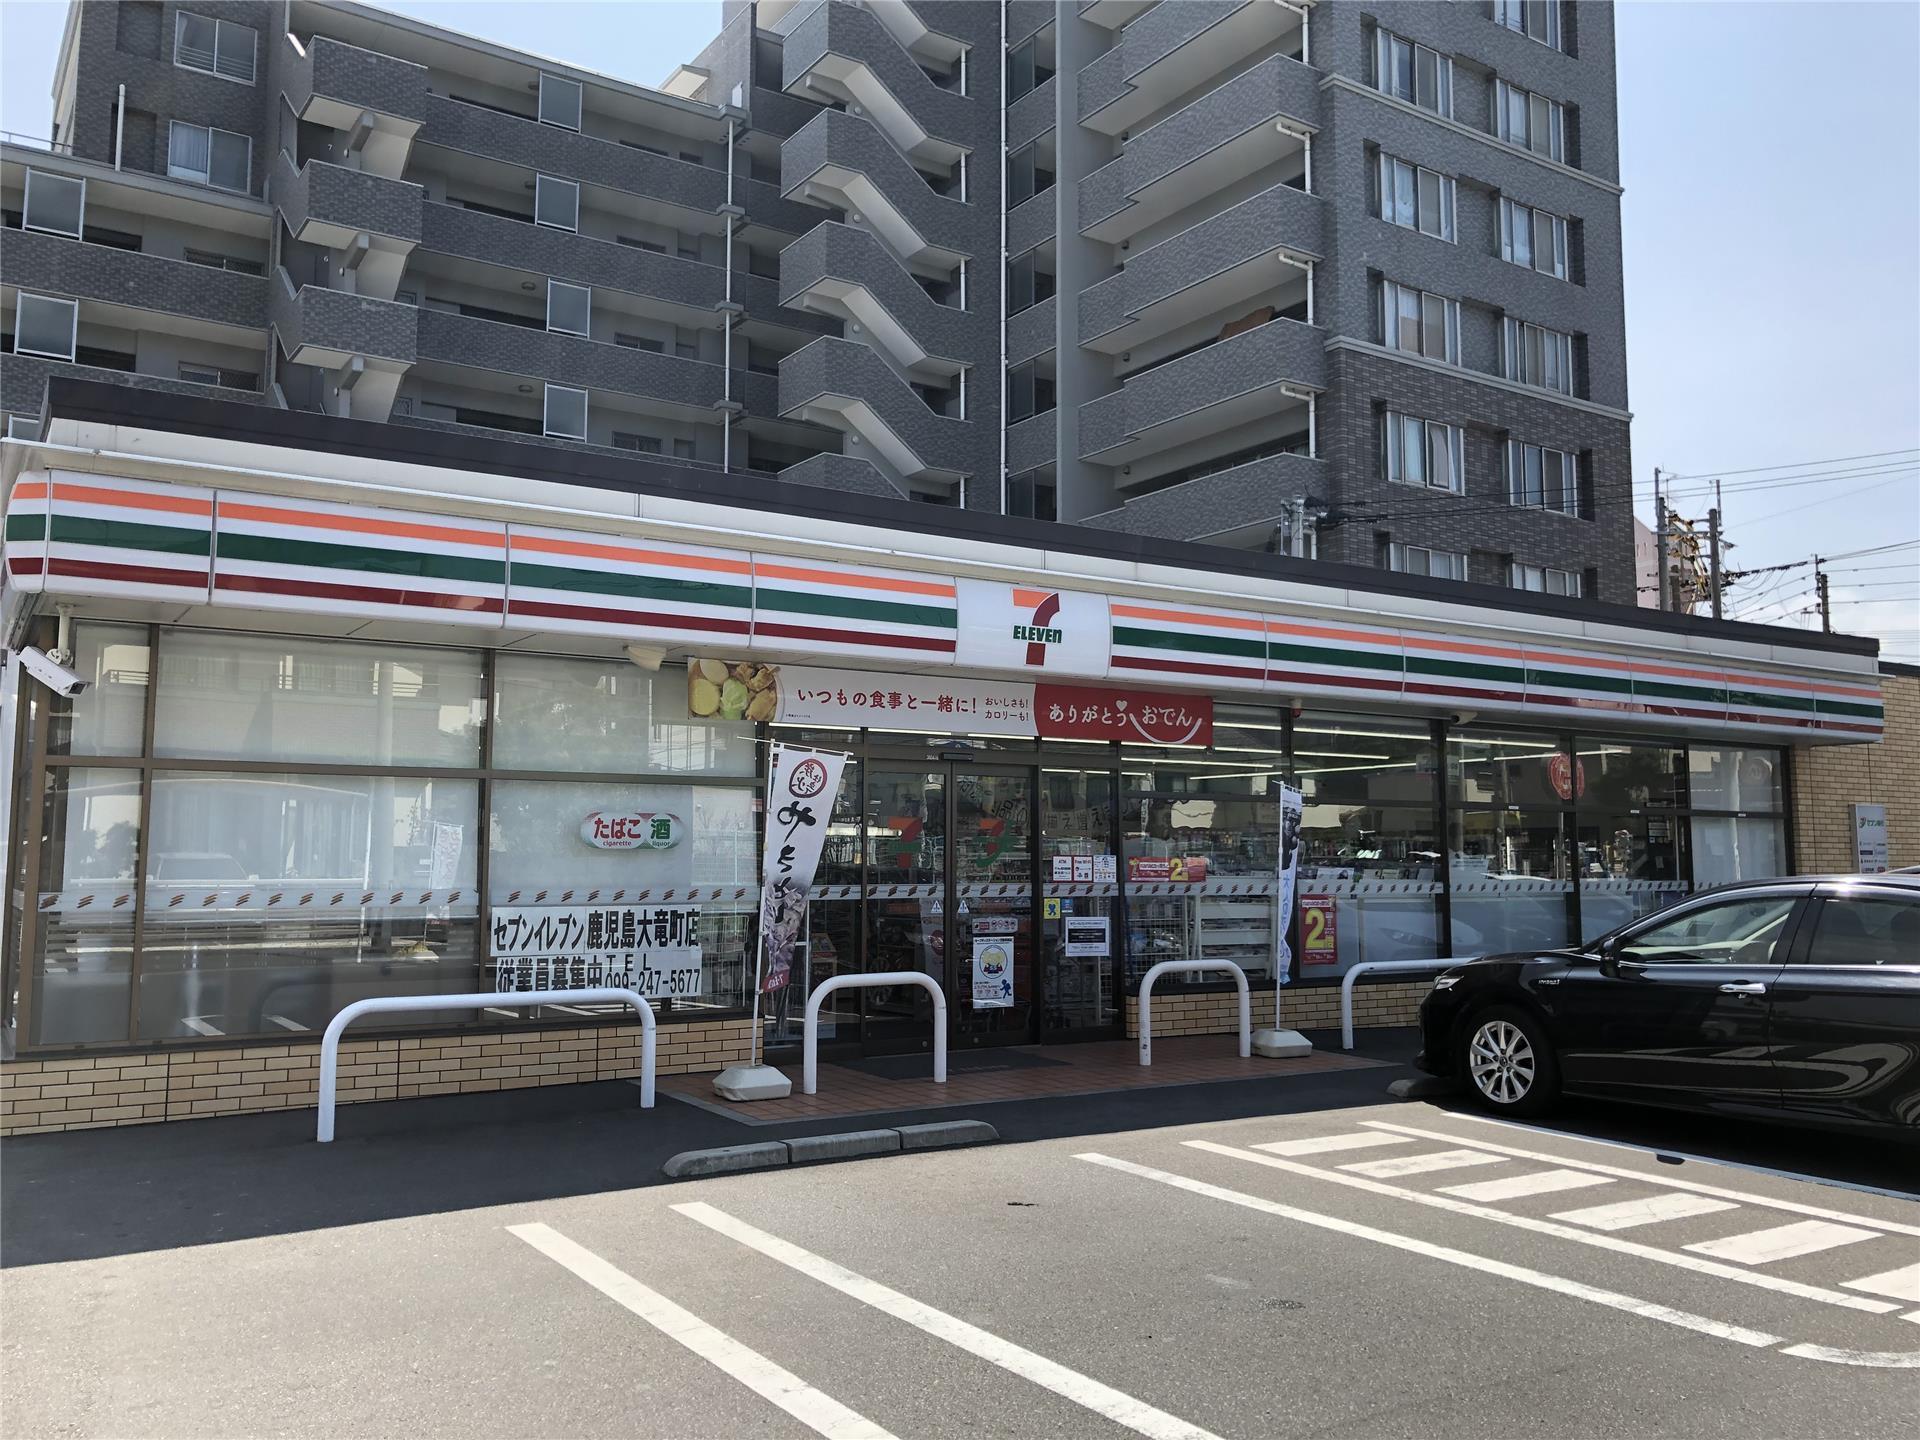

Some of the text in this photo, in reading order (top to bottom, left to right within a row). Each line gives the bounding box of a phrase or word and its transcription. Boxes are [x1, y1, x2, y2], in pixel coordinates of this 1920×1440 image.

[1012, 589, 1060, 666] 7
[797, 688, 977, 713] いつもの食事と一緒に!
[1049, 702, 1127, 727] ありがとう
[1141, 705, 1193, 727] おでん
[593, 817, 641, 839] たばこ
[650, 818, 671, 839] 酒
